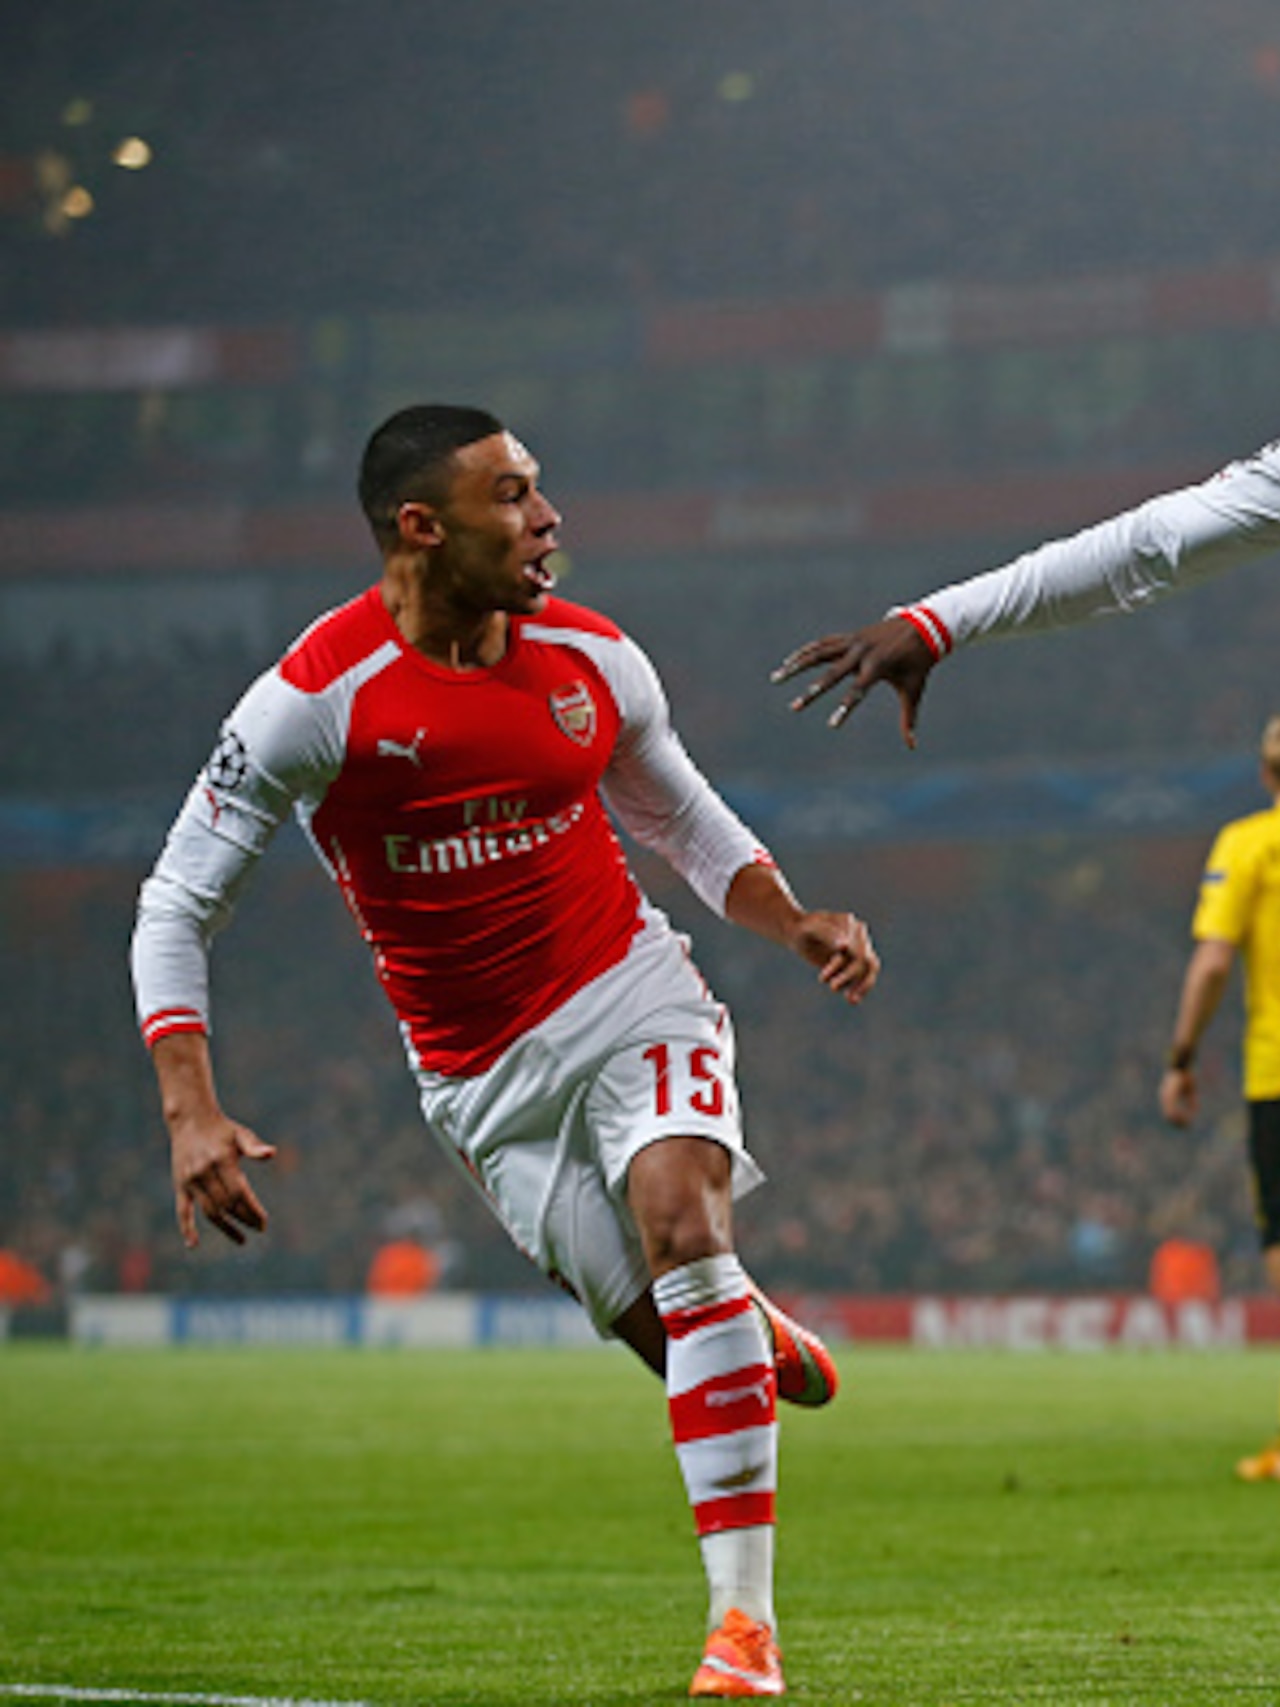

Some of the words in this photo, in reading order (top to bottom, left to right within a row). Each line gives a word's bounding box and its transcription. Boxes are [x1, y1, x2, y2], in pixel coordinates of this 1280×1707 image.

[384, 803, 584, 874] Emirates
[463, 796, 527, 826] Fly
[642, 1042, 724, 1117] 15
